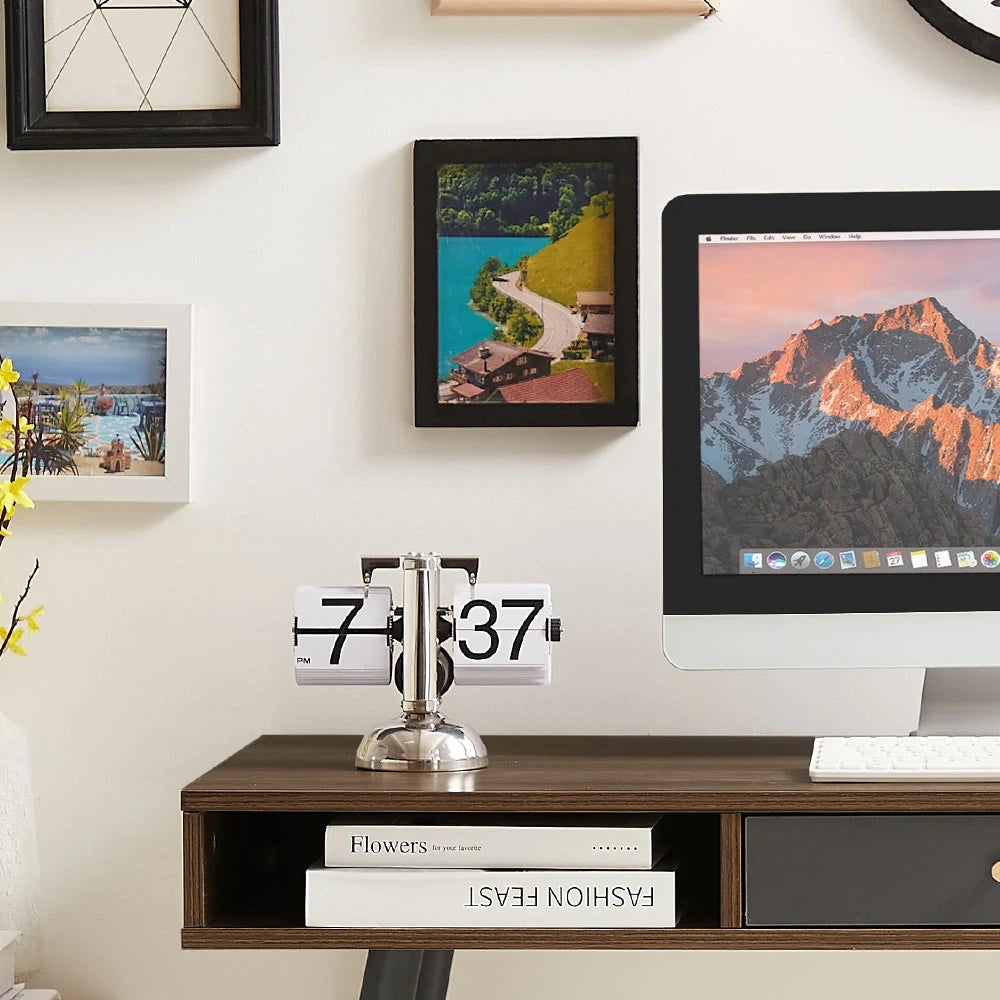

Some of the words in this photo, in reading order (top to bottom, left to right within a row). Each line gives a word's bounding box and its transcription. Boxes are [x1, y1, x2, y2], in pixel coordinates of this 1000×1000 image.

[321, 598, 365, 665] 7
[458, 598, 545, 661] 37
[296, 657, 312, 665] PM
[351, 835, 428, 854] Flowers
[431, 844, 441, 852] for
[442, 846, 457, 854] your
[459, 844, 482, 852] favorite
[463, 885, 539, 908] FEAST
[547, 885, 655, 908] FASHION
